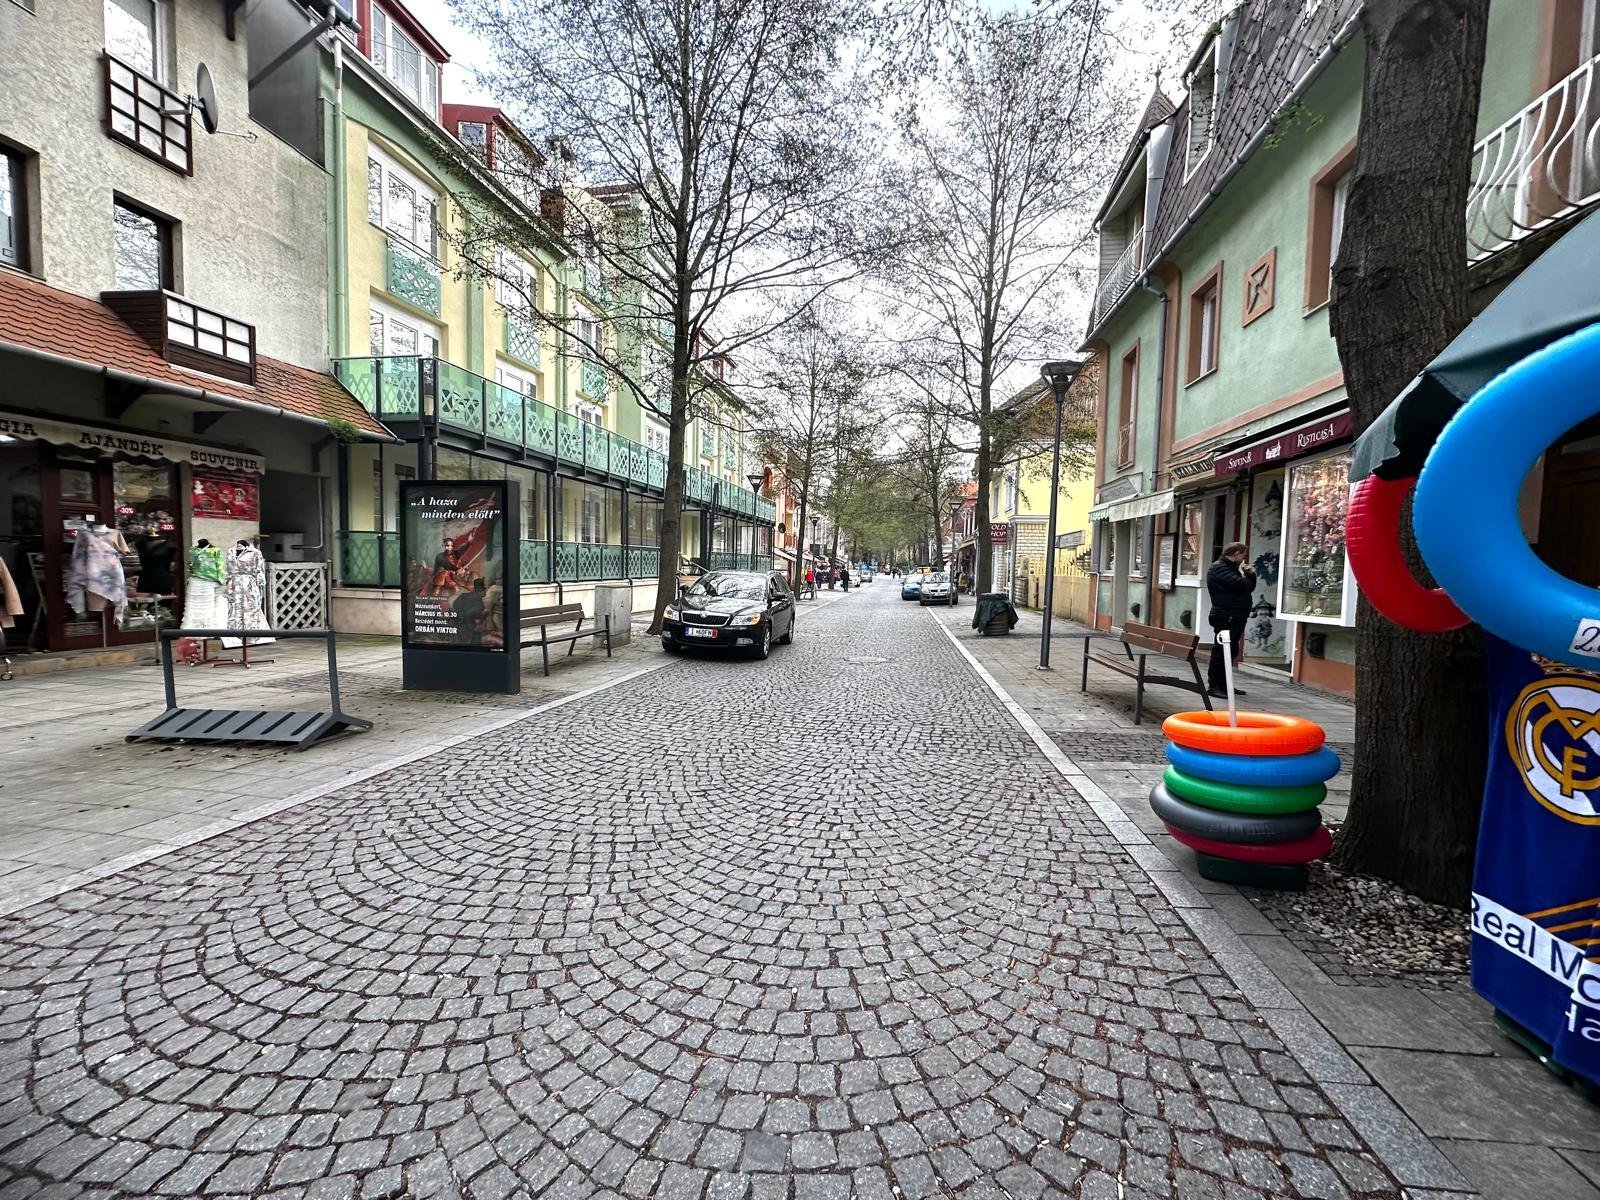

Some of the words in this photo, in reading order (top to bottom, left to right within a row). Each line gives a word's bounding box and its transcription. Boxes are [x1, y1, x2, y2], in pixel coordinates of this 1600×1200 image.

[79, 432, 164, 456] AJÁNDÉK
[190, 450, 259, 470] SOUVENIR
[428, 496, 458, 506] haza
[421, 509, 465, 519] minden
[414, 624, 435, 633] ORBÁN
[435, 626, 458, 634] VIKTOR
[1471, 894, 1537, 959] Real
